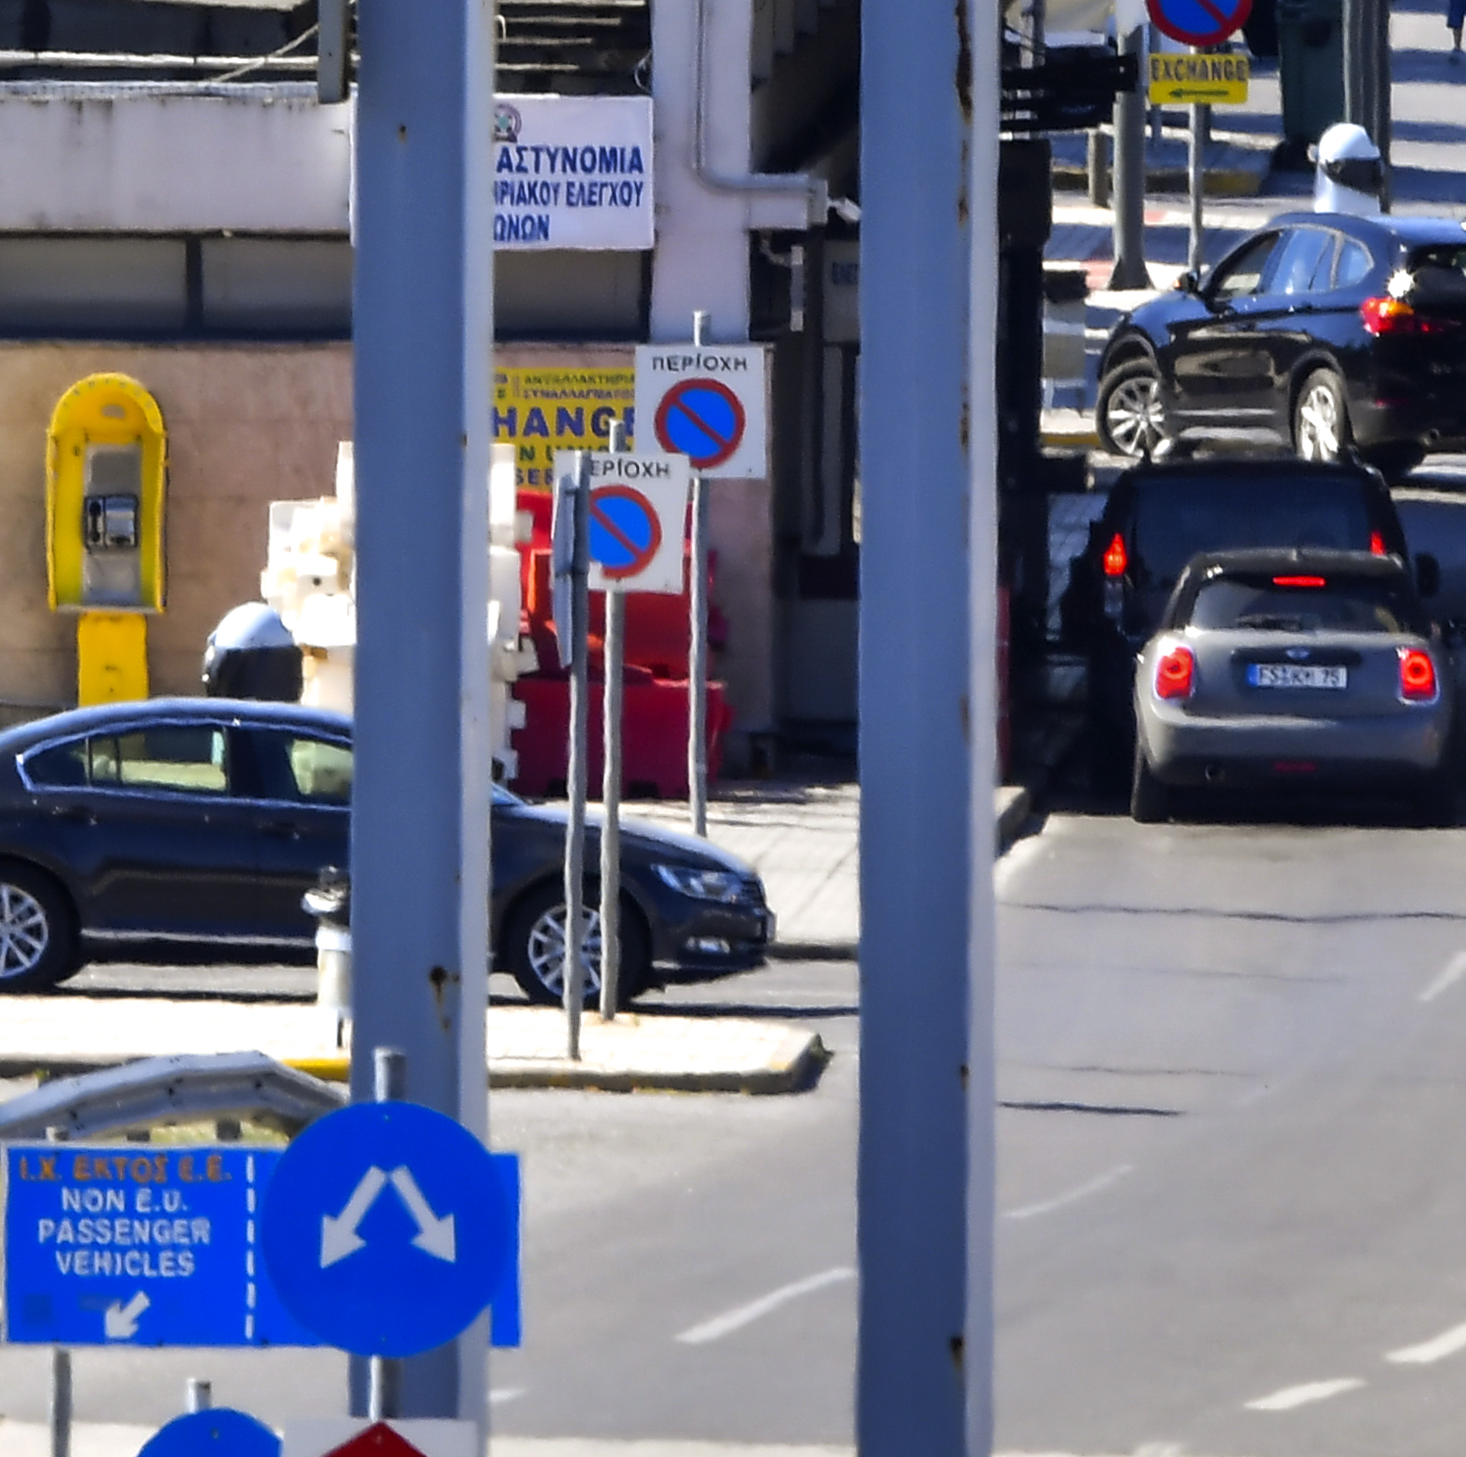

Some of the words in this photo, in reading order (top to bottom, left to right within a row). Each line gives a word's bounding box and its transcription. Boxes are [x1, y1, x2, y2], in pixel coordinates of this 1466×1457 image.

[1150, 58, 1248, 81] EXCHANGE
[496, 146, 644, 174] ΑΣΤΥΝΟΜΙΑ
[566, 180, 644, 206] ΕΛΕΓΧΟΥ
[73, 1155, 168, 1183] ΕΚΤΟΣ
[62, 1187, 126, 1212] NON
[136, 1187, 192, 1213] E.U.
[38, 1218, 211, 1245] PASSENGER
[55, 1249, 196, 1277] VEHICLES
